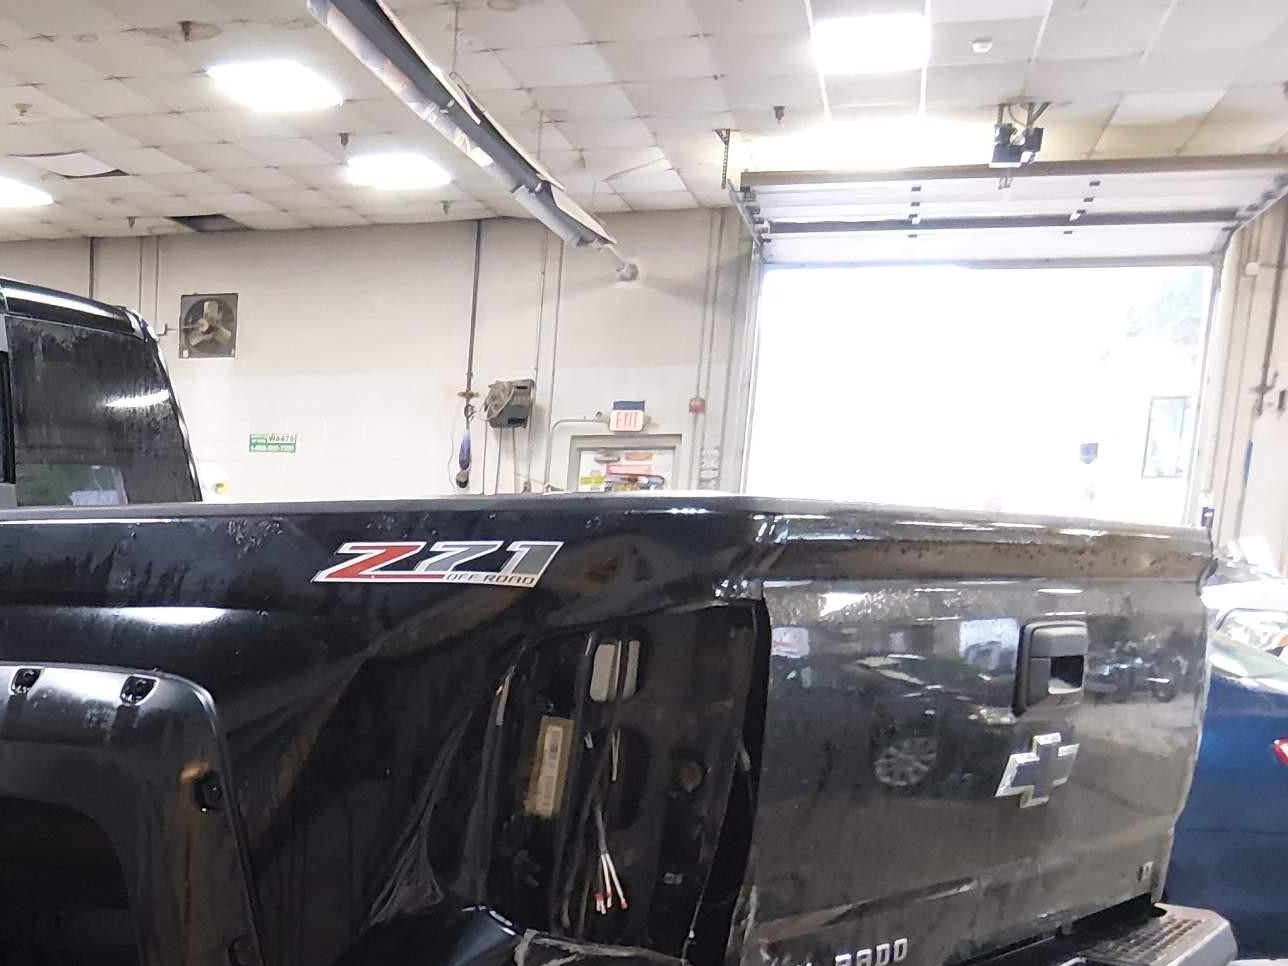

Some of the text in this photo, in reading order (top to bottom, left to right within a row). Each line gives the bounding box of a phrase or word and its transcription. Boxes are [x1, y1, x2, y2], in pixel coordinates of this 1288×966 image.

[616, 411, 639, 429] EXIT
[312, 541, 564, 583] Z71
[482, 575, 535, 585] ROAD
